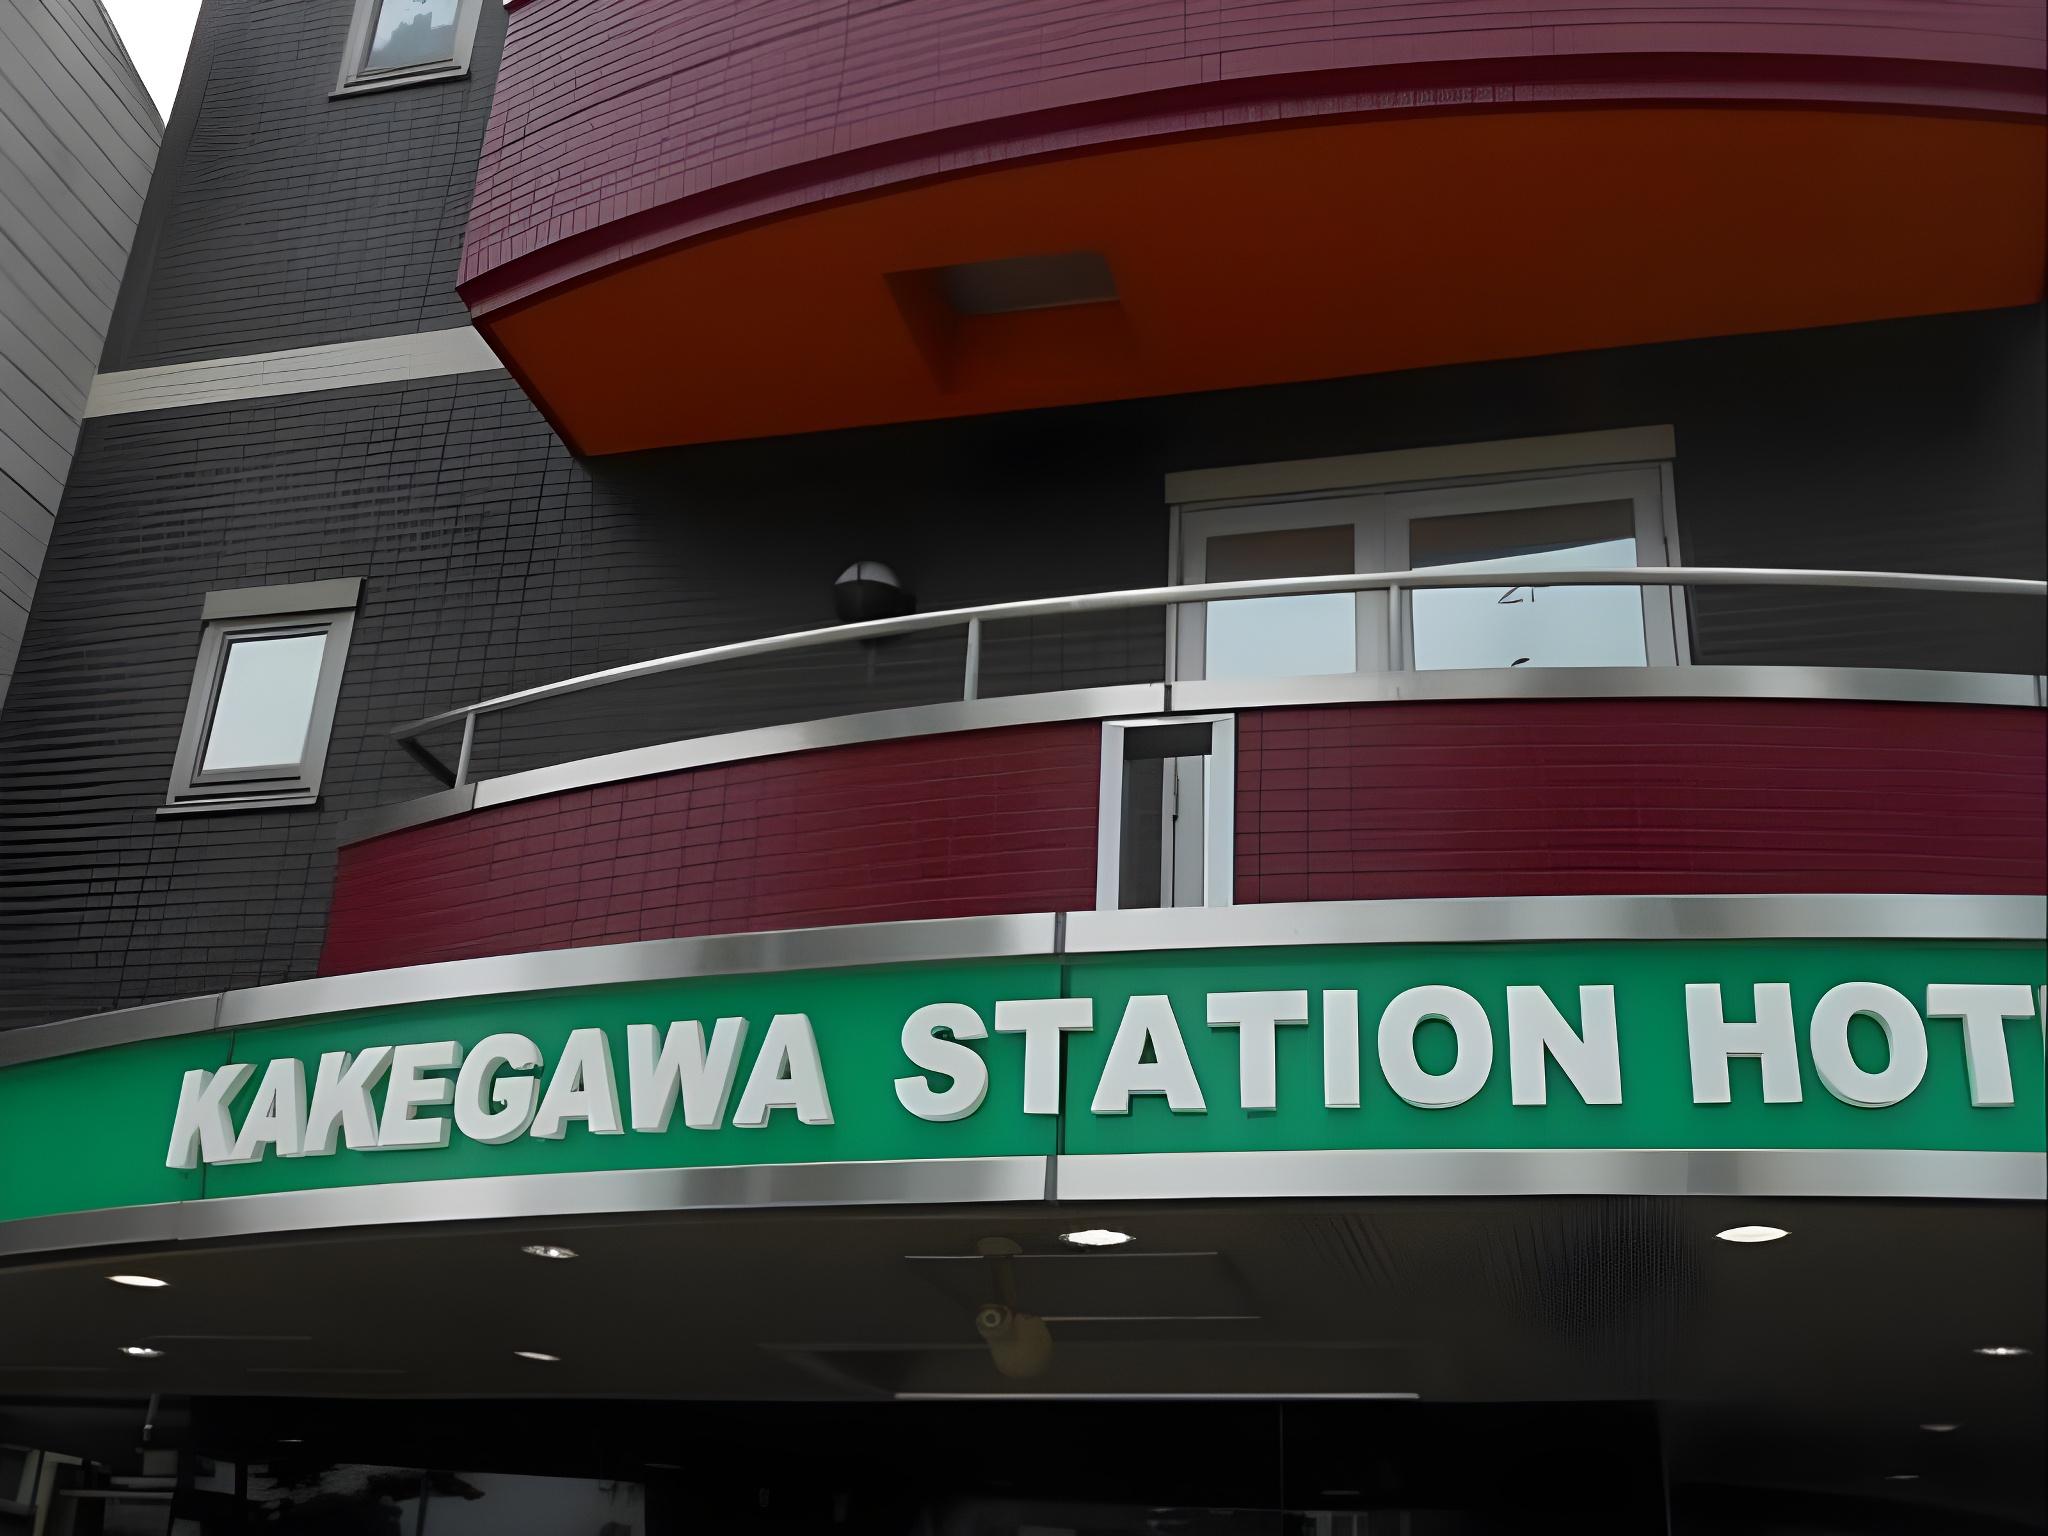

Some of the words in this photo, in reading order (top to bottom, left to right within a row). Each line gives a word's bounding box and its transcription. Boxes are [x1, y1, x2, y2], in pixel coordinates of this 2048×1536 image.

[166, 1013, 834, 1169] KAKEGAWA
[894, 984, 1623, 1122] STATION
[1685, 981, 2046, 1108] HOT
